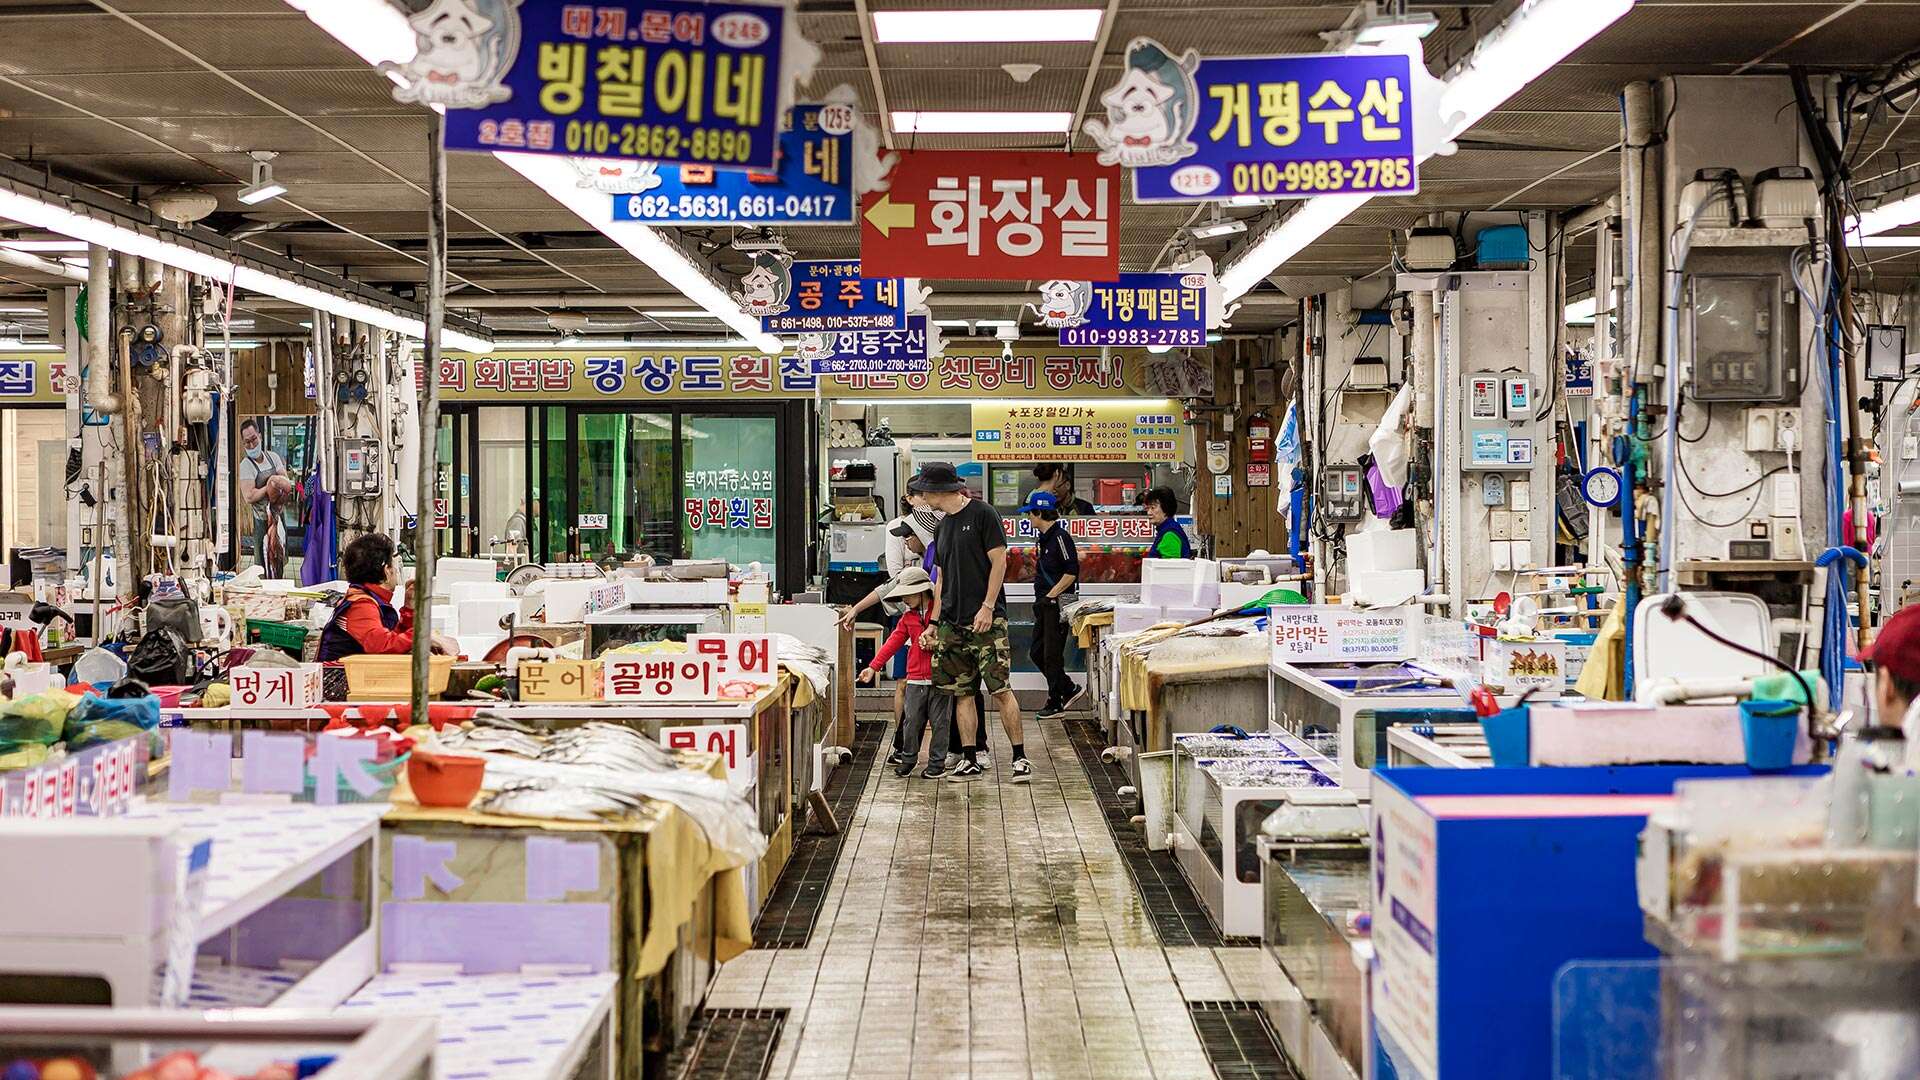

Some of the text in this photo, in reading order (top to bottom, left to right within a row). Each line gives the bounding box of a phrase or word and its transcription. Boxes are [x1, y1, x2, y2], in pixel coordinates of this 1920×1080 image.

[537, 42, 764, 127] 빙칠이네
[1208, 77, 1404, 147] 거평수산
[565, 119, 751, 163] 010-2862-8890
[1232, 158, 1411, 193] 010-9983-2785
[926, 175, 1109, 256] 화장실
[1183, 276, 1206, 287] 119호
[1094, 288, 1200, 322] 거평패밀리
[781, 315, 894, 330] 661-1498, 010-5375-1498
[1067, 329, 1200, 345] 010-9983-2785
[839, 329, 925, 355] 화동수산
[475, 358, 575, 392] 회덮밥
[584, 354, 817, 395] 경상도횟집
[1043, 356, 1124, 390] 공짜!
[684, 496, 773, 530] 명화횟집
[1070, 519, 1119, 538] 매운탕
[1275, 625, 1329, 645] 골라먹는
[233, 671, 294, 706] 멍게
[519, 664, 585, 695] 문어
[610, 660, 710, 695] 골뱅이
